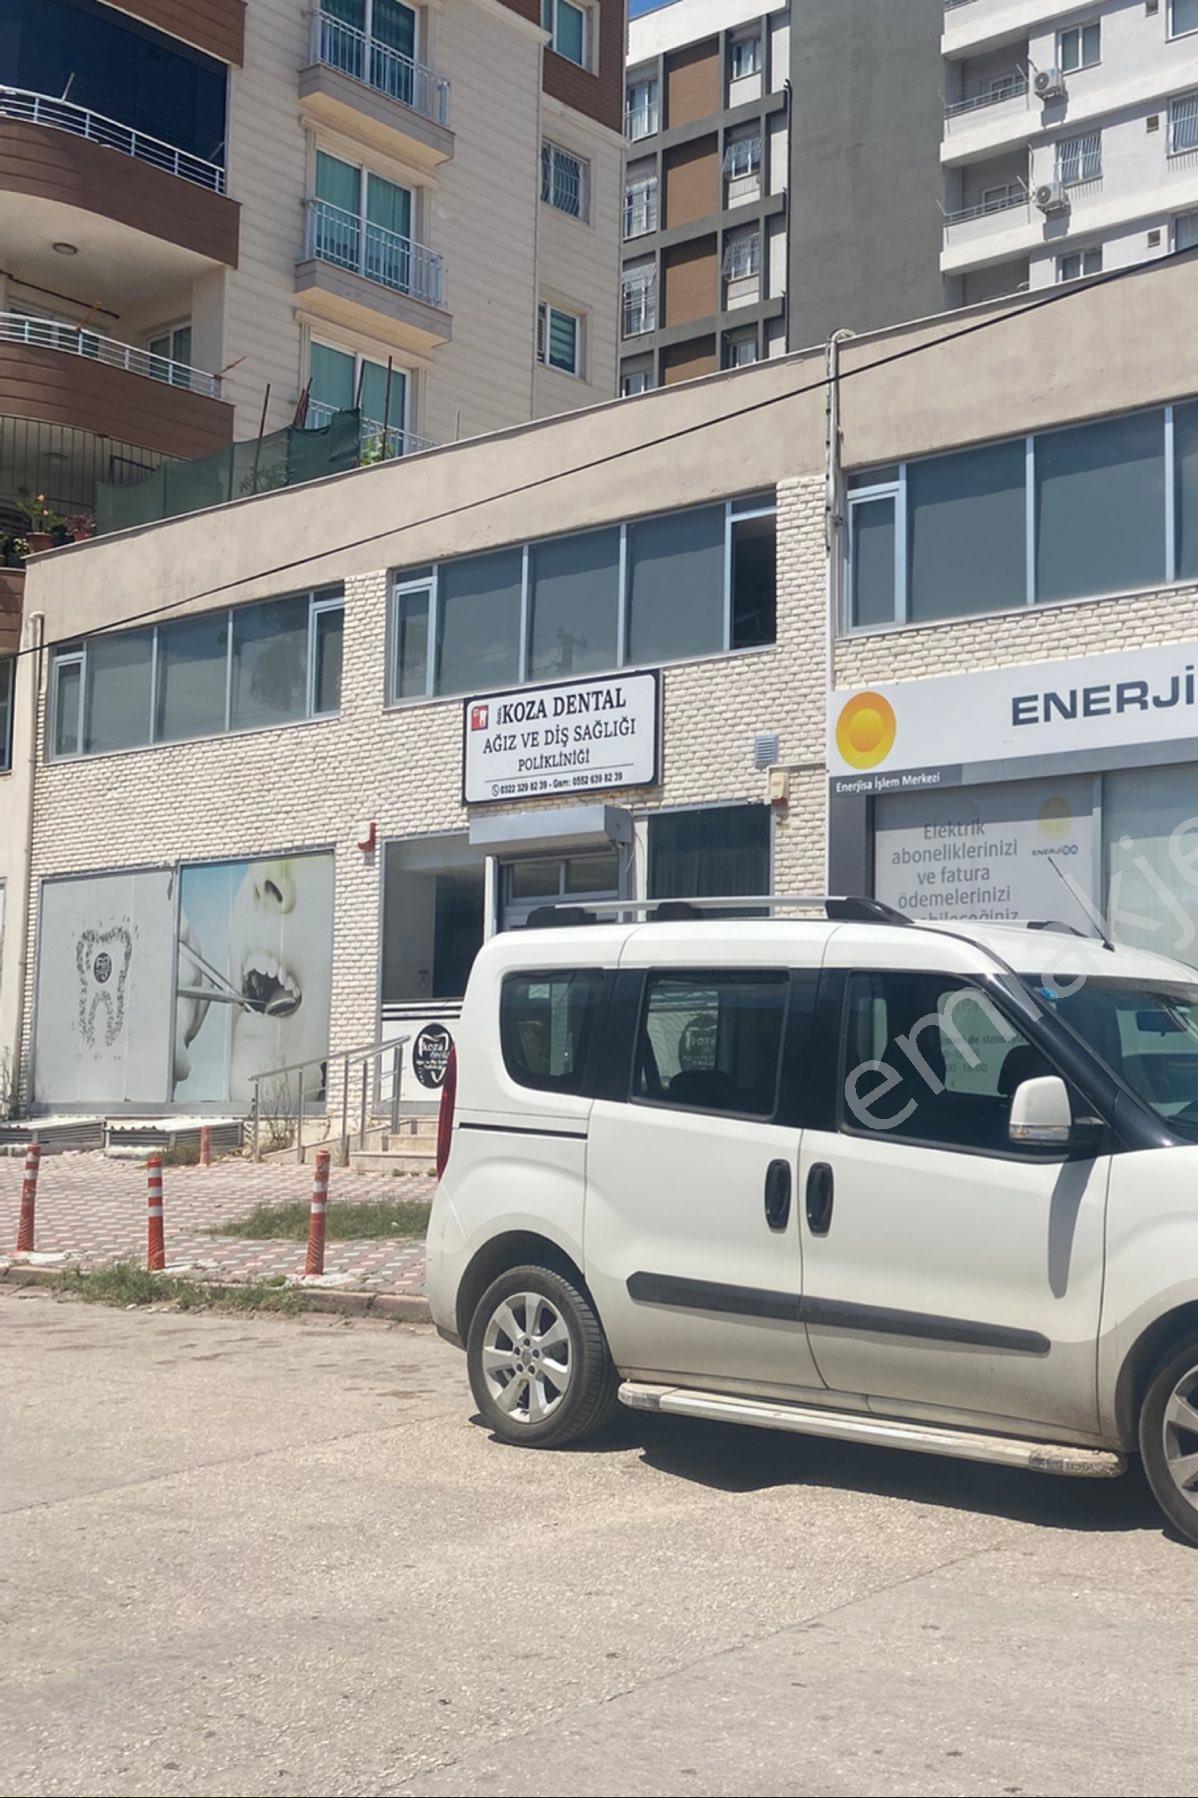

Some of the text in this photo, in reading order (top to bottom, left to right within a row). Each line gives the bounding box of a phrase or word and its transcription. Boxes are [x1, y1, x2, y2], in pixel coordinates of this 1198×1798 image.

[502, 699, 547, 724] KOZA
[553, 687, 626, 717] DENTAL
[483, 716, 636, 754] AĞIZ VE DİŞ SAĞLIĞI
[518, 748, 590, 772] POLİKLİNİĞİ
[836, 772, 940, 793] Enerjisa İşlem Merkezi
[923, 818, 986, 840] Elektrik
[892, 839, 1018, 865] aboneliklerinizi
[917, 866, 990, 885] ve fatura
[898, 885, 1011, 909] ödemelerinizi
